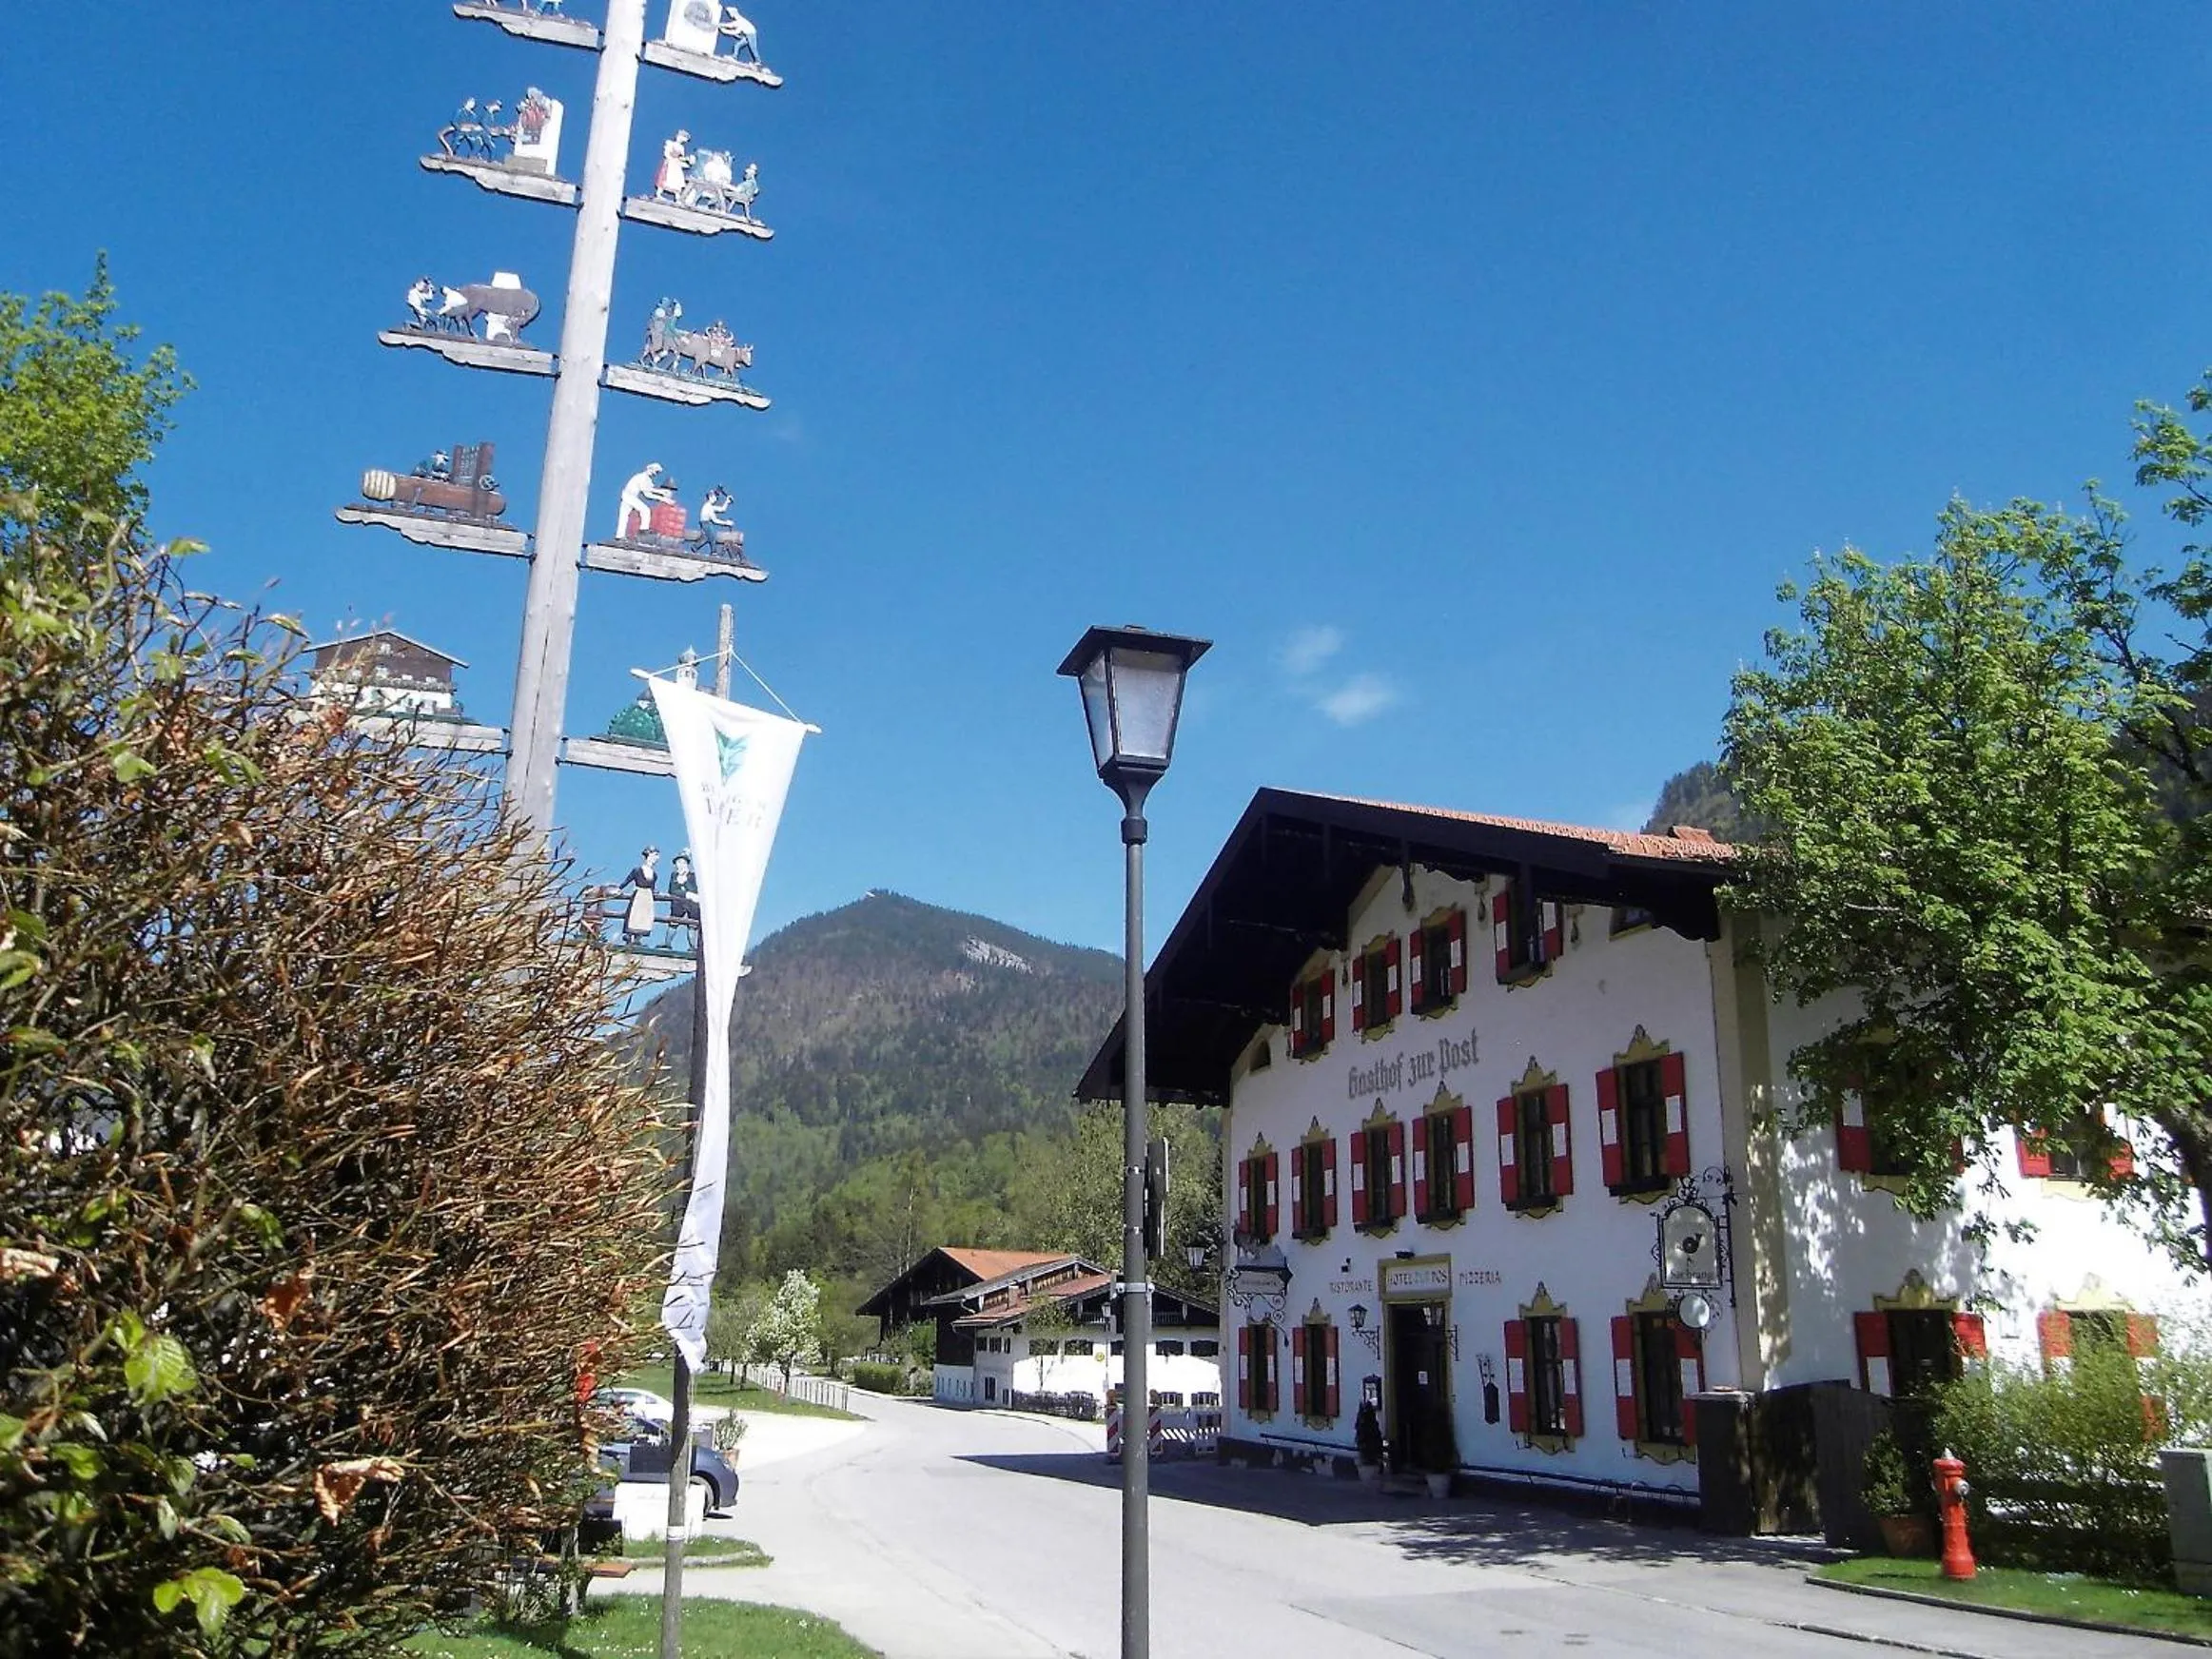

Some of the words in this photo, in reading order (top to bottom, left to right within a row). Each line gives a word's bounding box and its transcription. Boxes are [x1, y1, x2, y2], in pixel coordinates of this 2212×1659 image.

[1347, 1051, 1404, 1099] Gasthof
[1407, 1050, 1435, 1088] zur
[1438, 1027, 1479, 1079] Post
[1458, 1270, 1501, 1286] PIZZERIA
